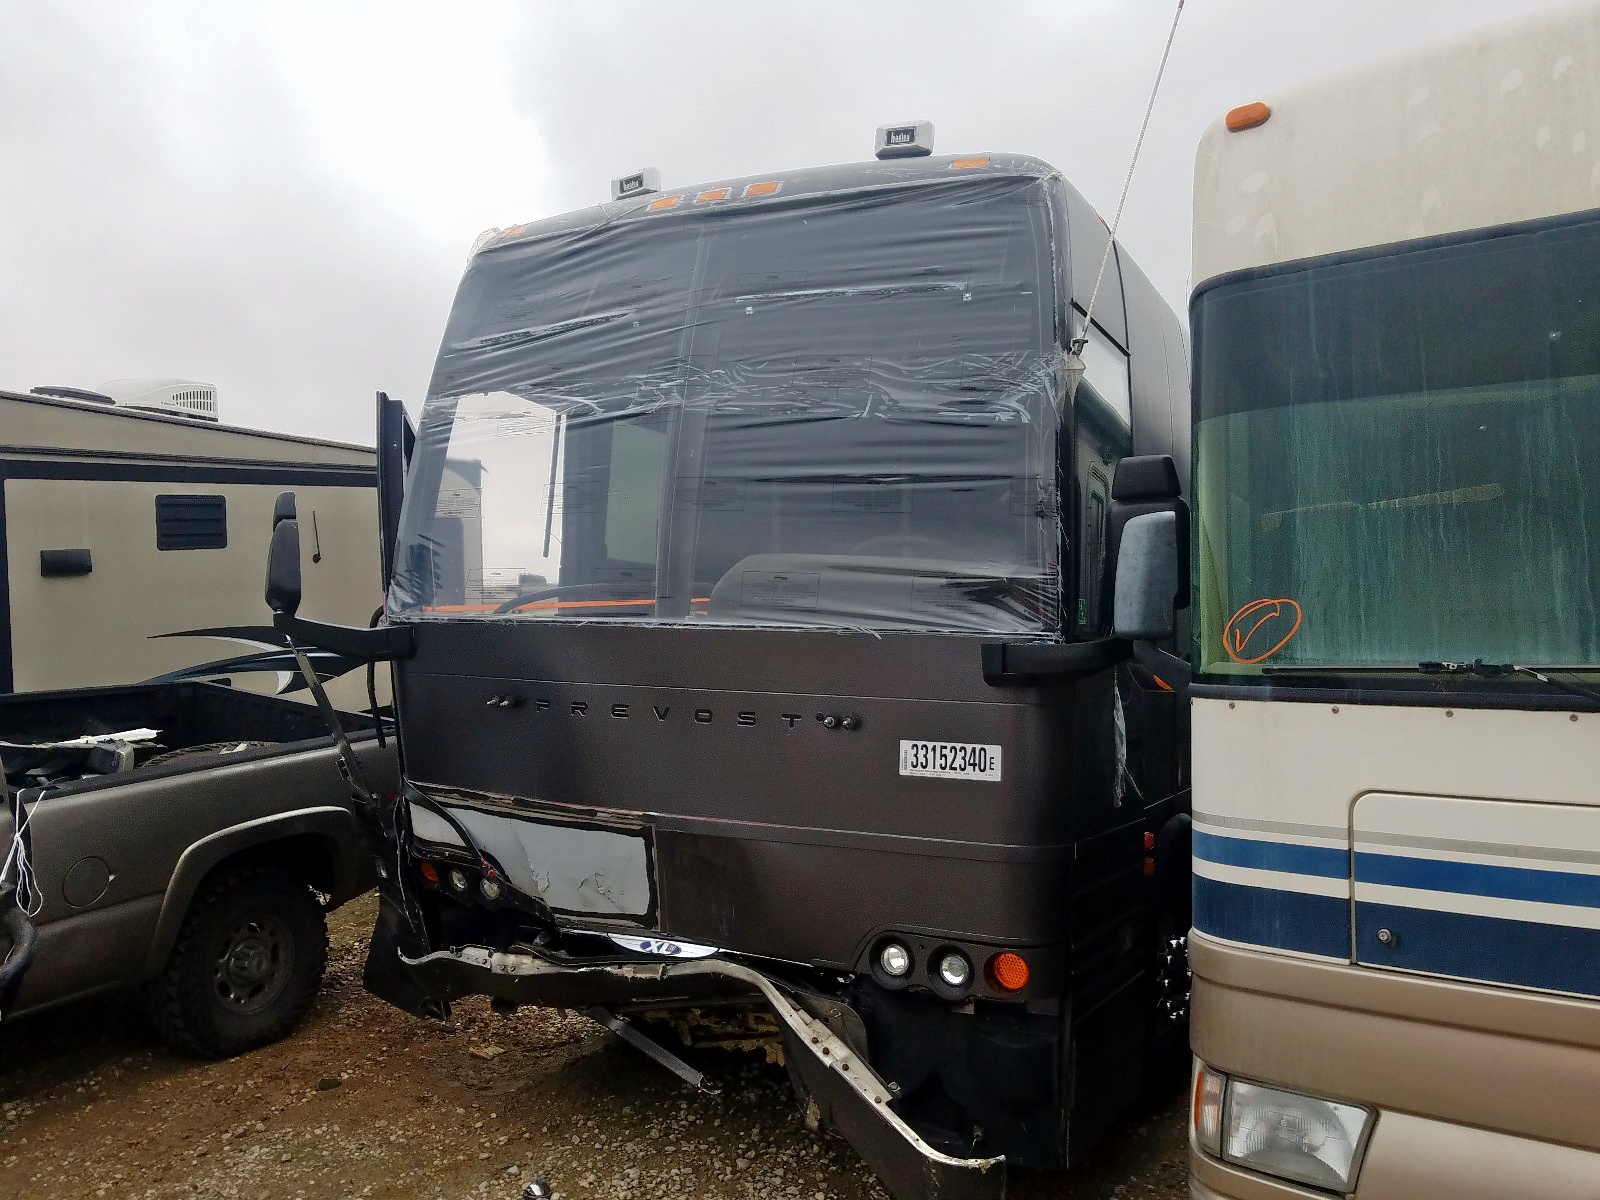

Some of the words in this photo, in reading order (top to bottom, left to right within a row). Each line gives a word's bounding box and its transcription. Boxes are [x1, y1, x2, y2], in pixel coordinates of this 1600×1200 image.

[535, 700, 802, 729] PREVOST
[911, 743, 987, 773] 33152340
[988, 756, 995, 771] E
